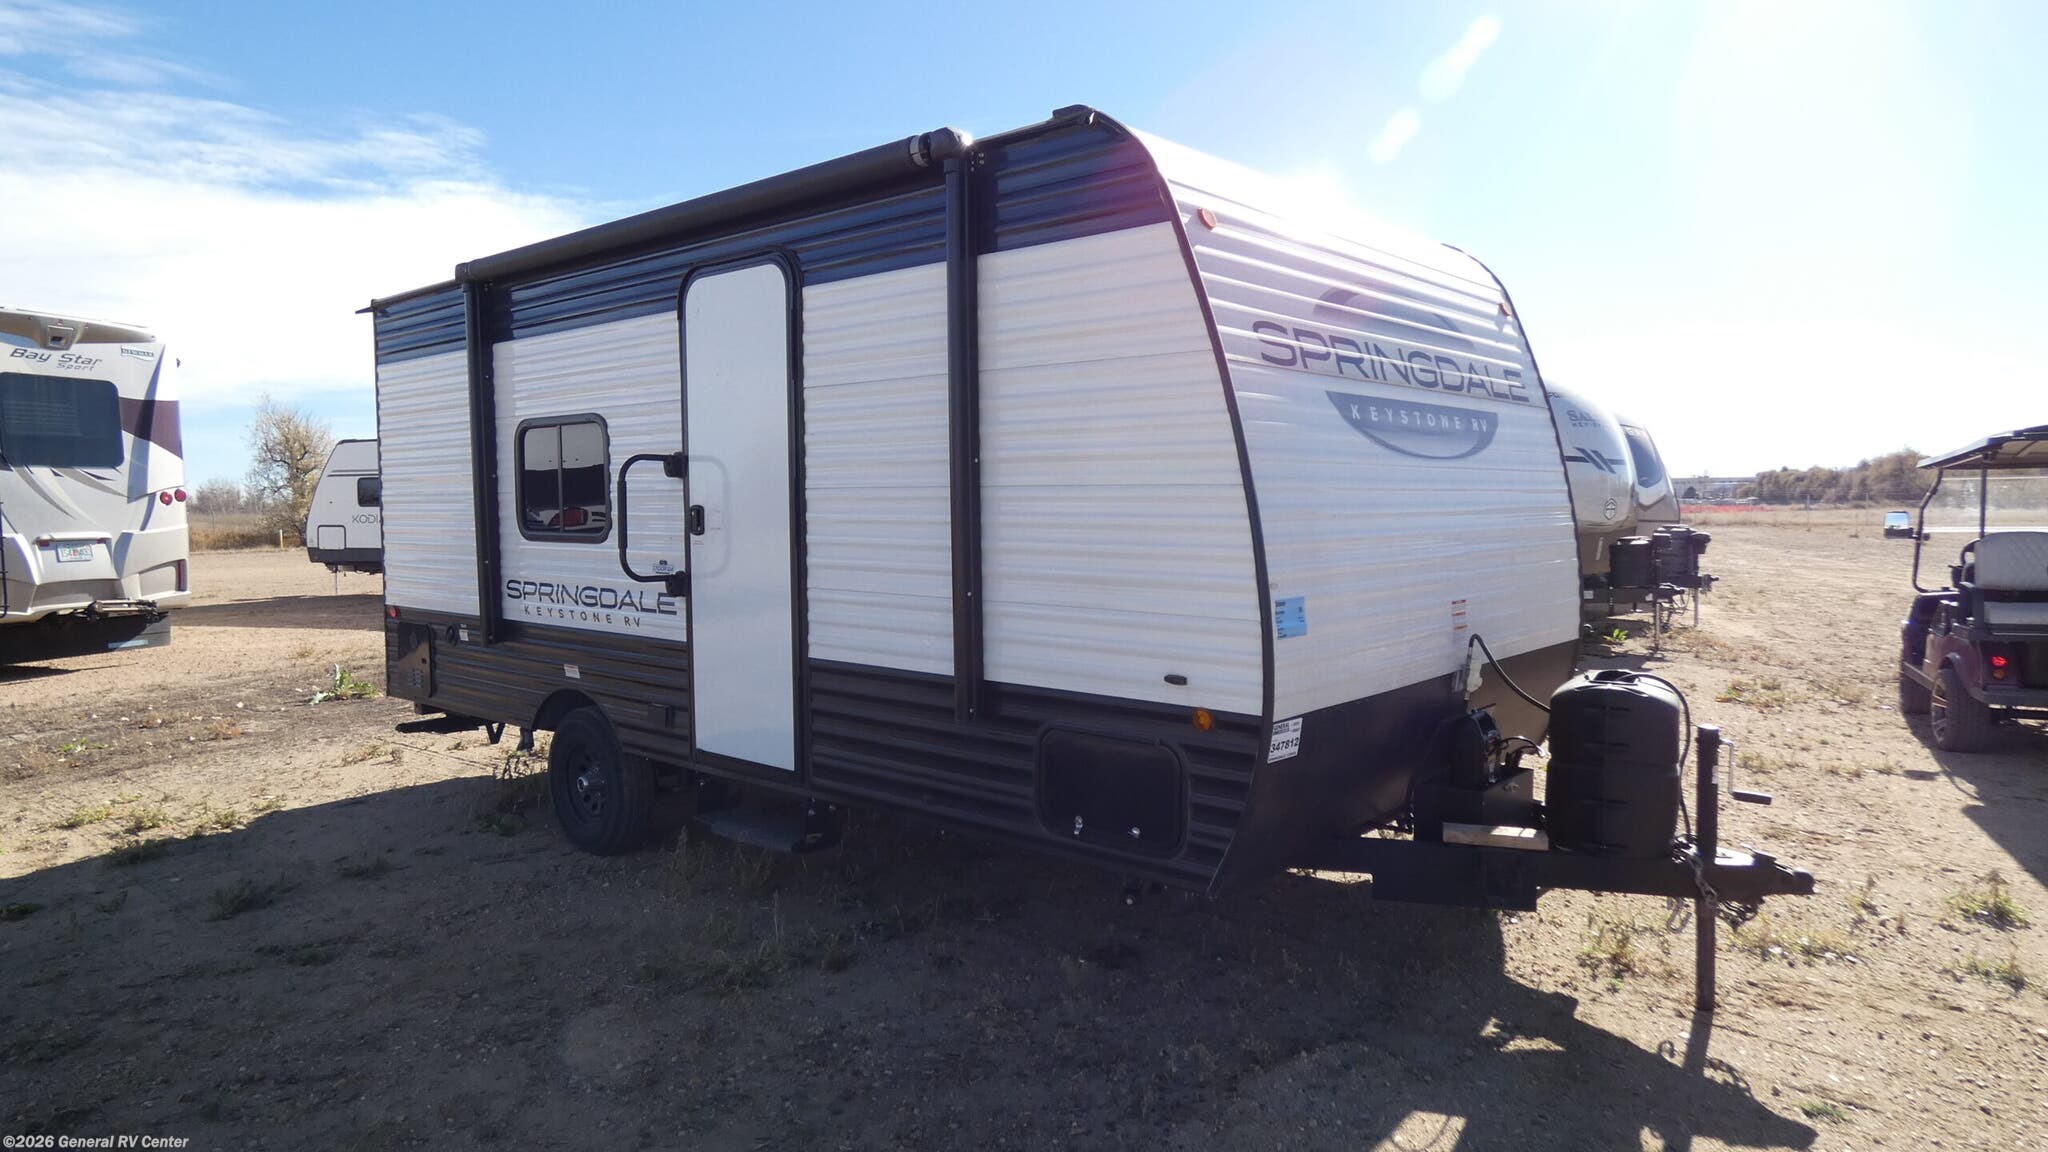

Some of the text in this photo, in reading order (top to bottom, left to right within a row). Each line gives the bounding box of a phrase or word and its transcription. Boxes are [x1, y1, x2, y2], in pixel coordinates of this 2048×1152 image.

[10, 347, 102, 366] Bay Star
[56, 362, 95, 372] Sport
[1252, 320, 1530, 402] SPRINGDALE
[1350, 404, 1488, 433] KEYSTONE RV
[506, 579, 678, 616] SPRINGDALE
[524, 605, 641, 628] KEYSTONE RV
[1270, 737, 1300, 754] 347812
